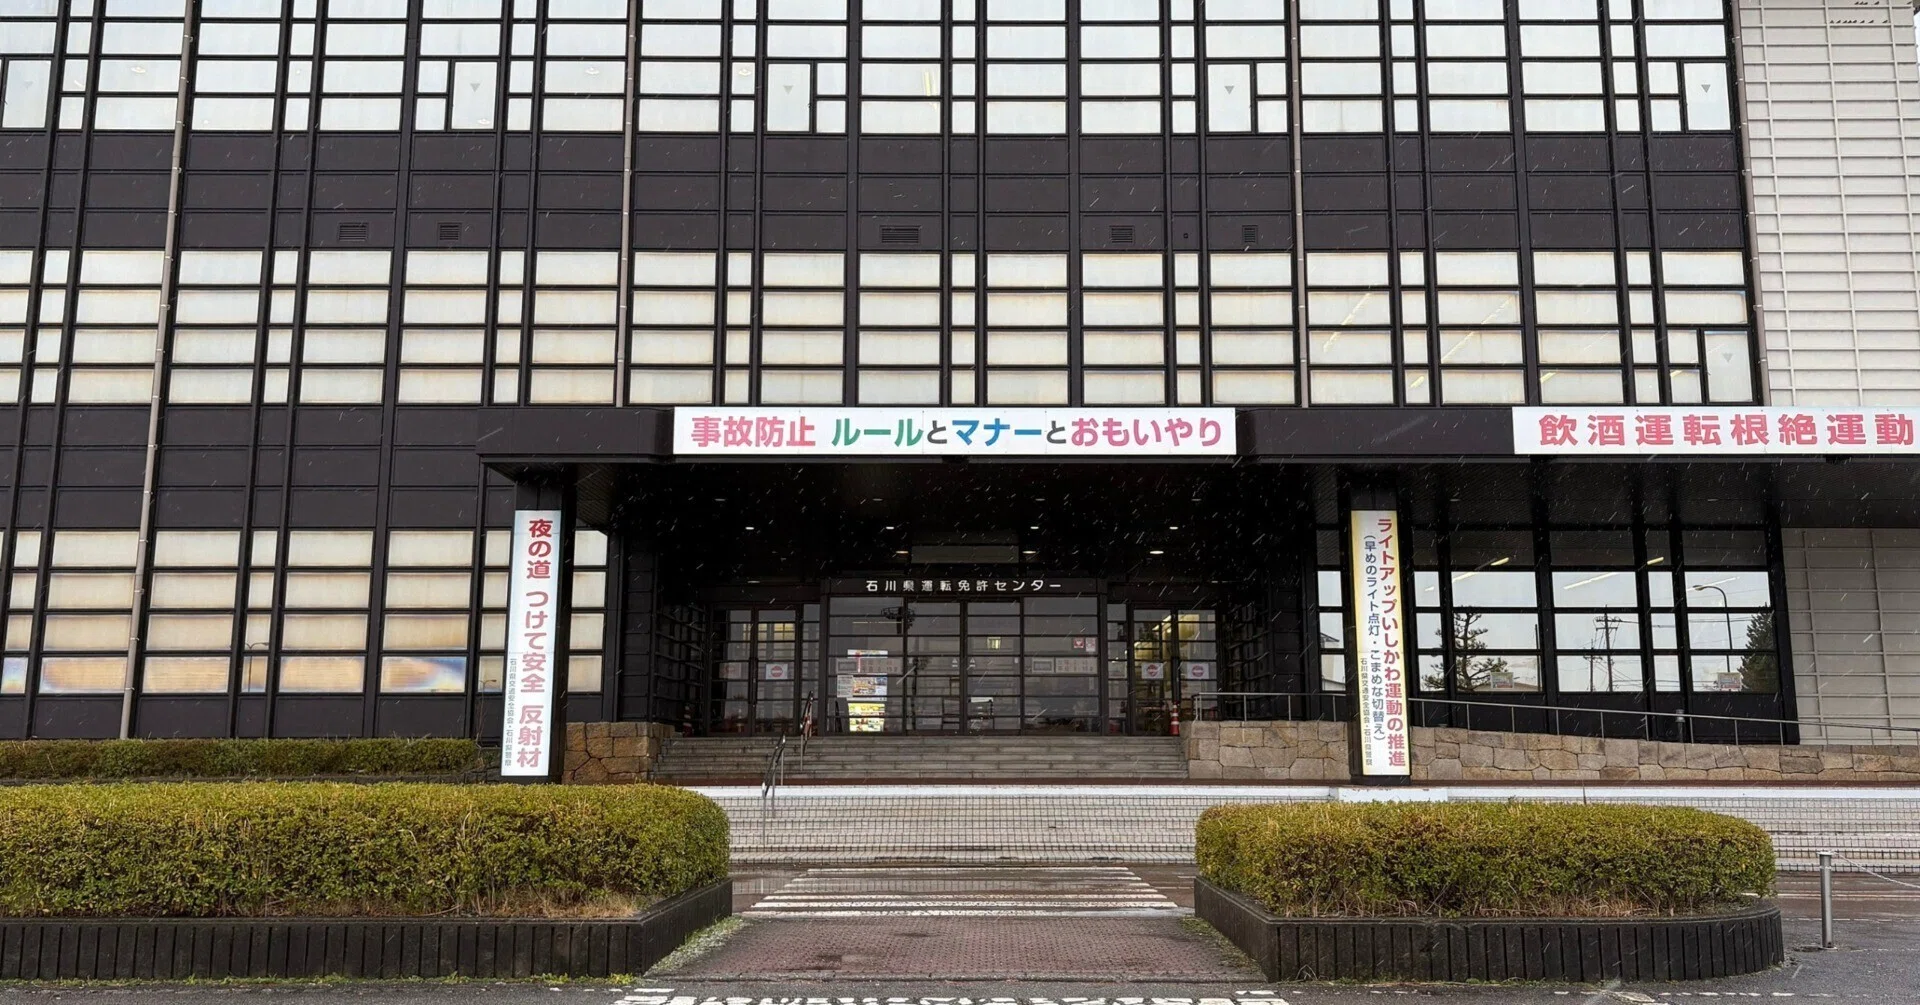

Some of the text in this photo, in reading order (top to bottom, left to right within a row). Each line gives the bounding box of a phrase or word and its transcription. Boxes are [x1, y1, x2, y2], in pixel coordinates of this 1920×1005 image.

[691, 416, 1222, 447] 事故防止 ルールとマナーとおもいやり
[1539, 414, 1914, 446] 飲酒運転根絶運動
[866, 580, 1062, 592] 石川県運転免許センター
[516, 519, 553, 768] 夜の道 つけて安全 反射材
[1377, 519, 1406, 767] ライトアップいしかわ運動の推進
